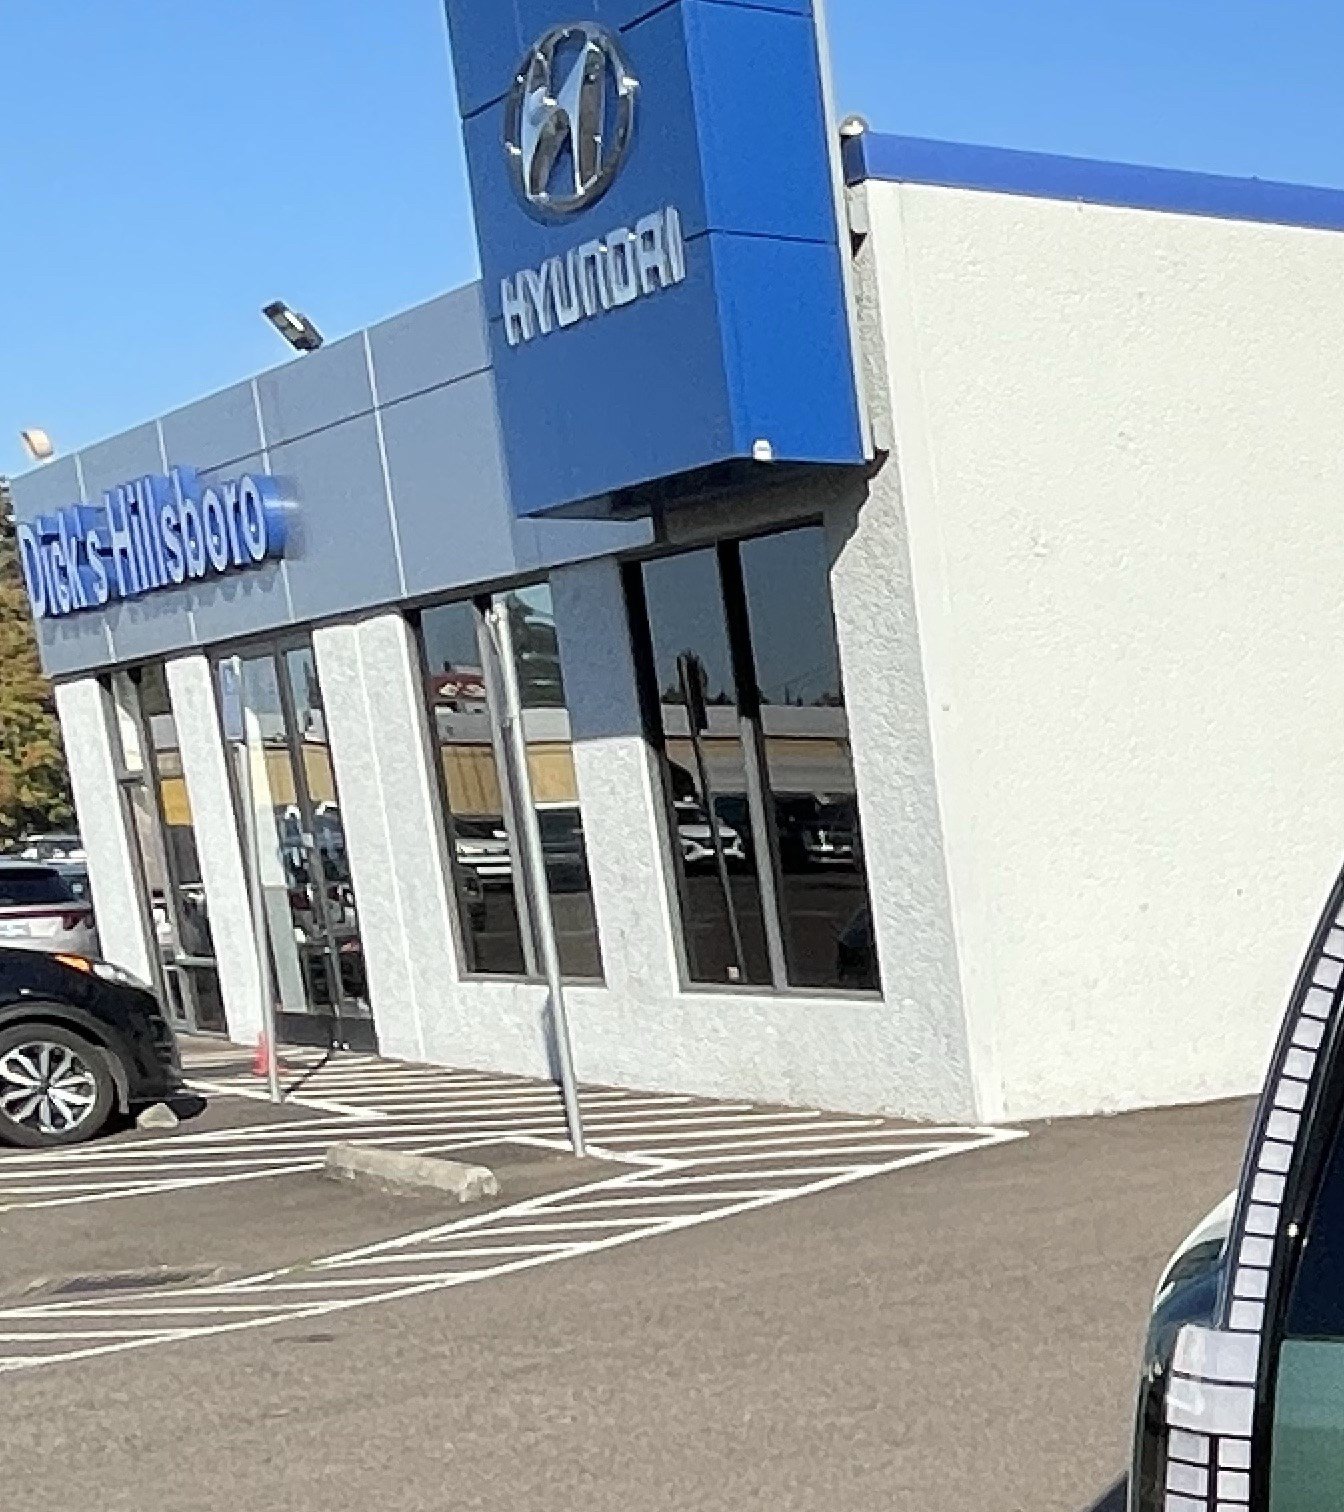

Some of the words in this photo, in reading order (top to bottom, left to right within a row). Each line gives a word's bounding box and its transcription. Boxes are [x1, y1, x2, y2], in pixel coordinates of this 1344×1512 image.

[501, 205, 686, 346] HYUNDAI
[17, 506, 108, 618] Dick's
[104, 469, 267, 597] Hillsboro
